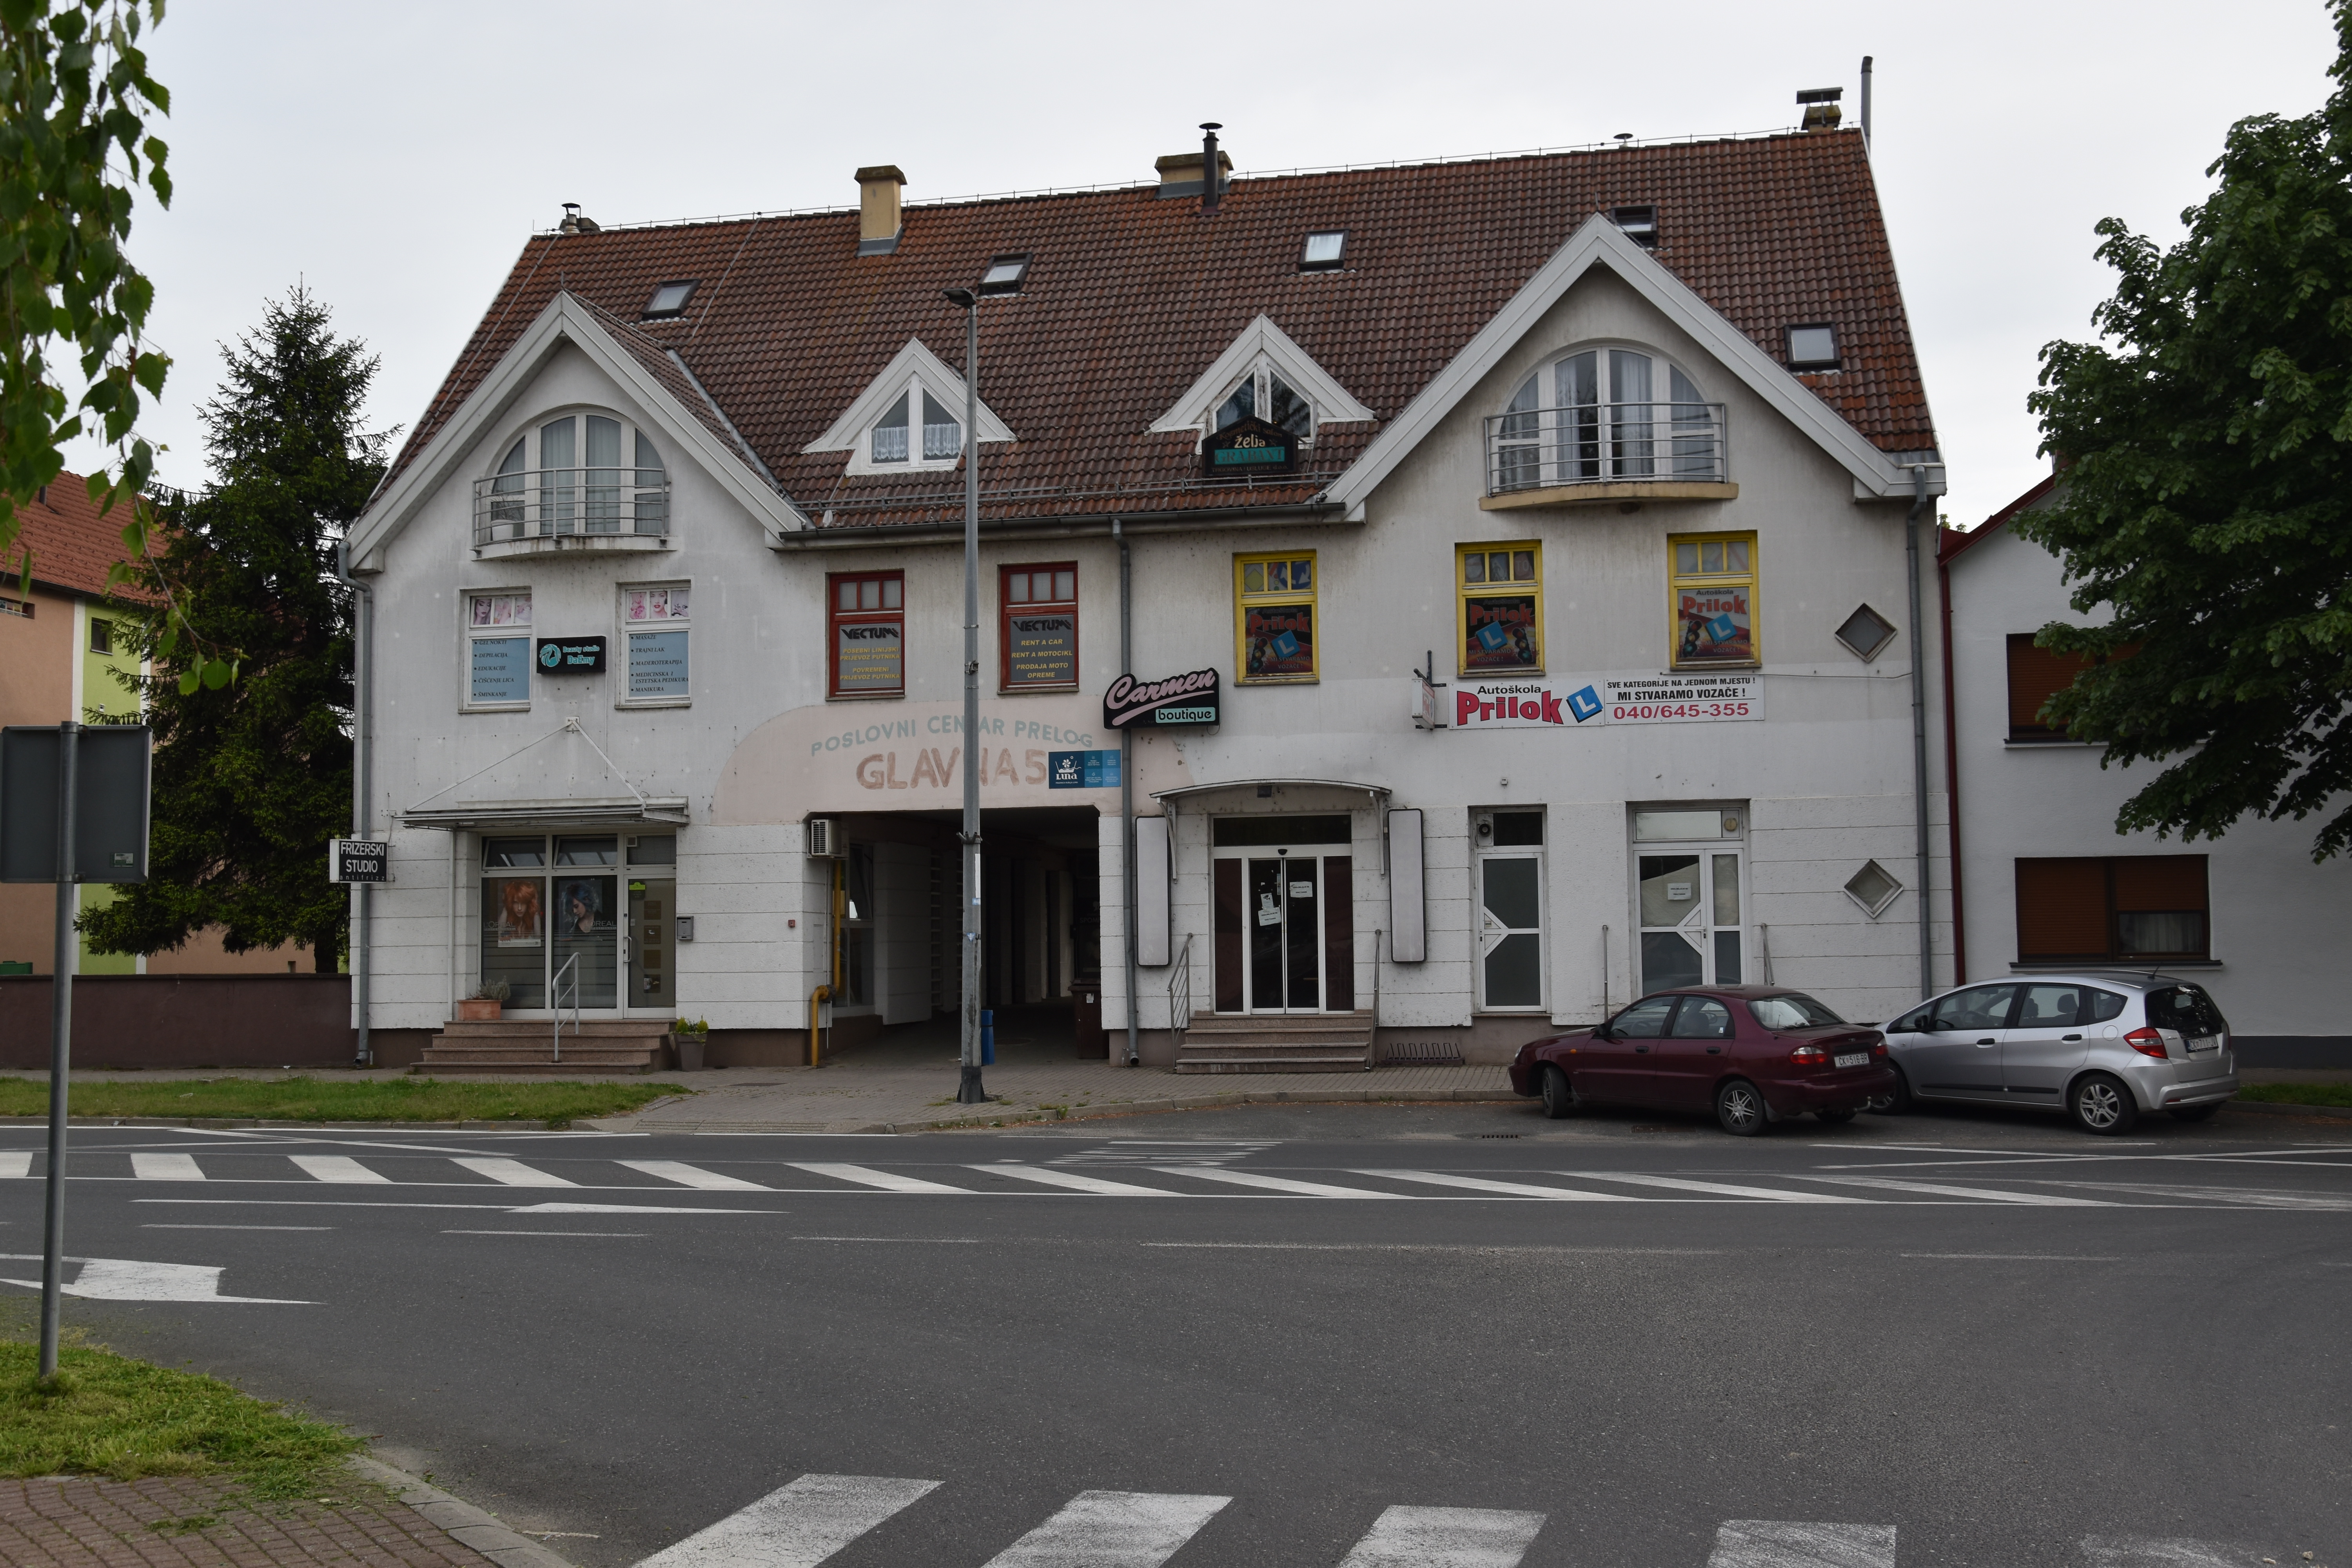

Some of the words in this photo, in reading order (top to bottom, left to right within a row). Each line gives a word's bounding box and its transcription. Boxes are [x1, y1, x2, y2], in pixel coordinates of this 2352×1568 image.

[1263, 427, 1282, 437] salon
[1682, 595, 1747, 616] Prilok
[1470, 603, 1532, 626] Prilok
[1012, 619, 1072, 632] VECTUM
[1250, 612, 1310, 633] Prilok
[841, 628, 899, 639] VECTUM
[567, 655, 595, 665] DaEmy
[1106, 670, 1216, 710] Carmen
[1477, 684, 1541, 695] Autoškola
[1624, 680, 1669, 688] KATEGORIJE
[1617, 692, 1631, 701] MI
[1635, 689, 1693, 701] STVARAMO
[1697, 686, 1738, 699] VOZAČE
[1158, 708, 1212, 721] boutique
[1457, 690, 1564, 726] Prilok
[1613, 703, 1749, 719] 040/645-355
[811, 719, 916, 757] POSLOVNI
[927, 715, 1004, 735] CENAR
[1014, 720, 1093, 748] PRELOG
[1025, 749, 1047, 785] 5
[341, 842, 384, 856] FRIZERSKI
[346, 859, 378, 873] STUDIO
